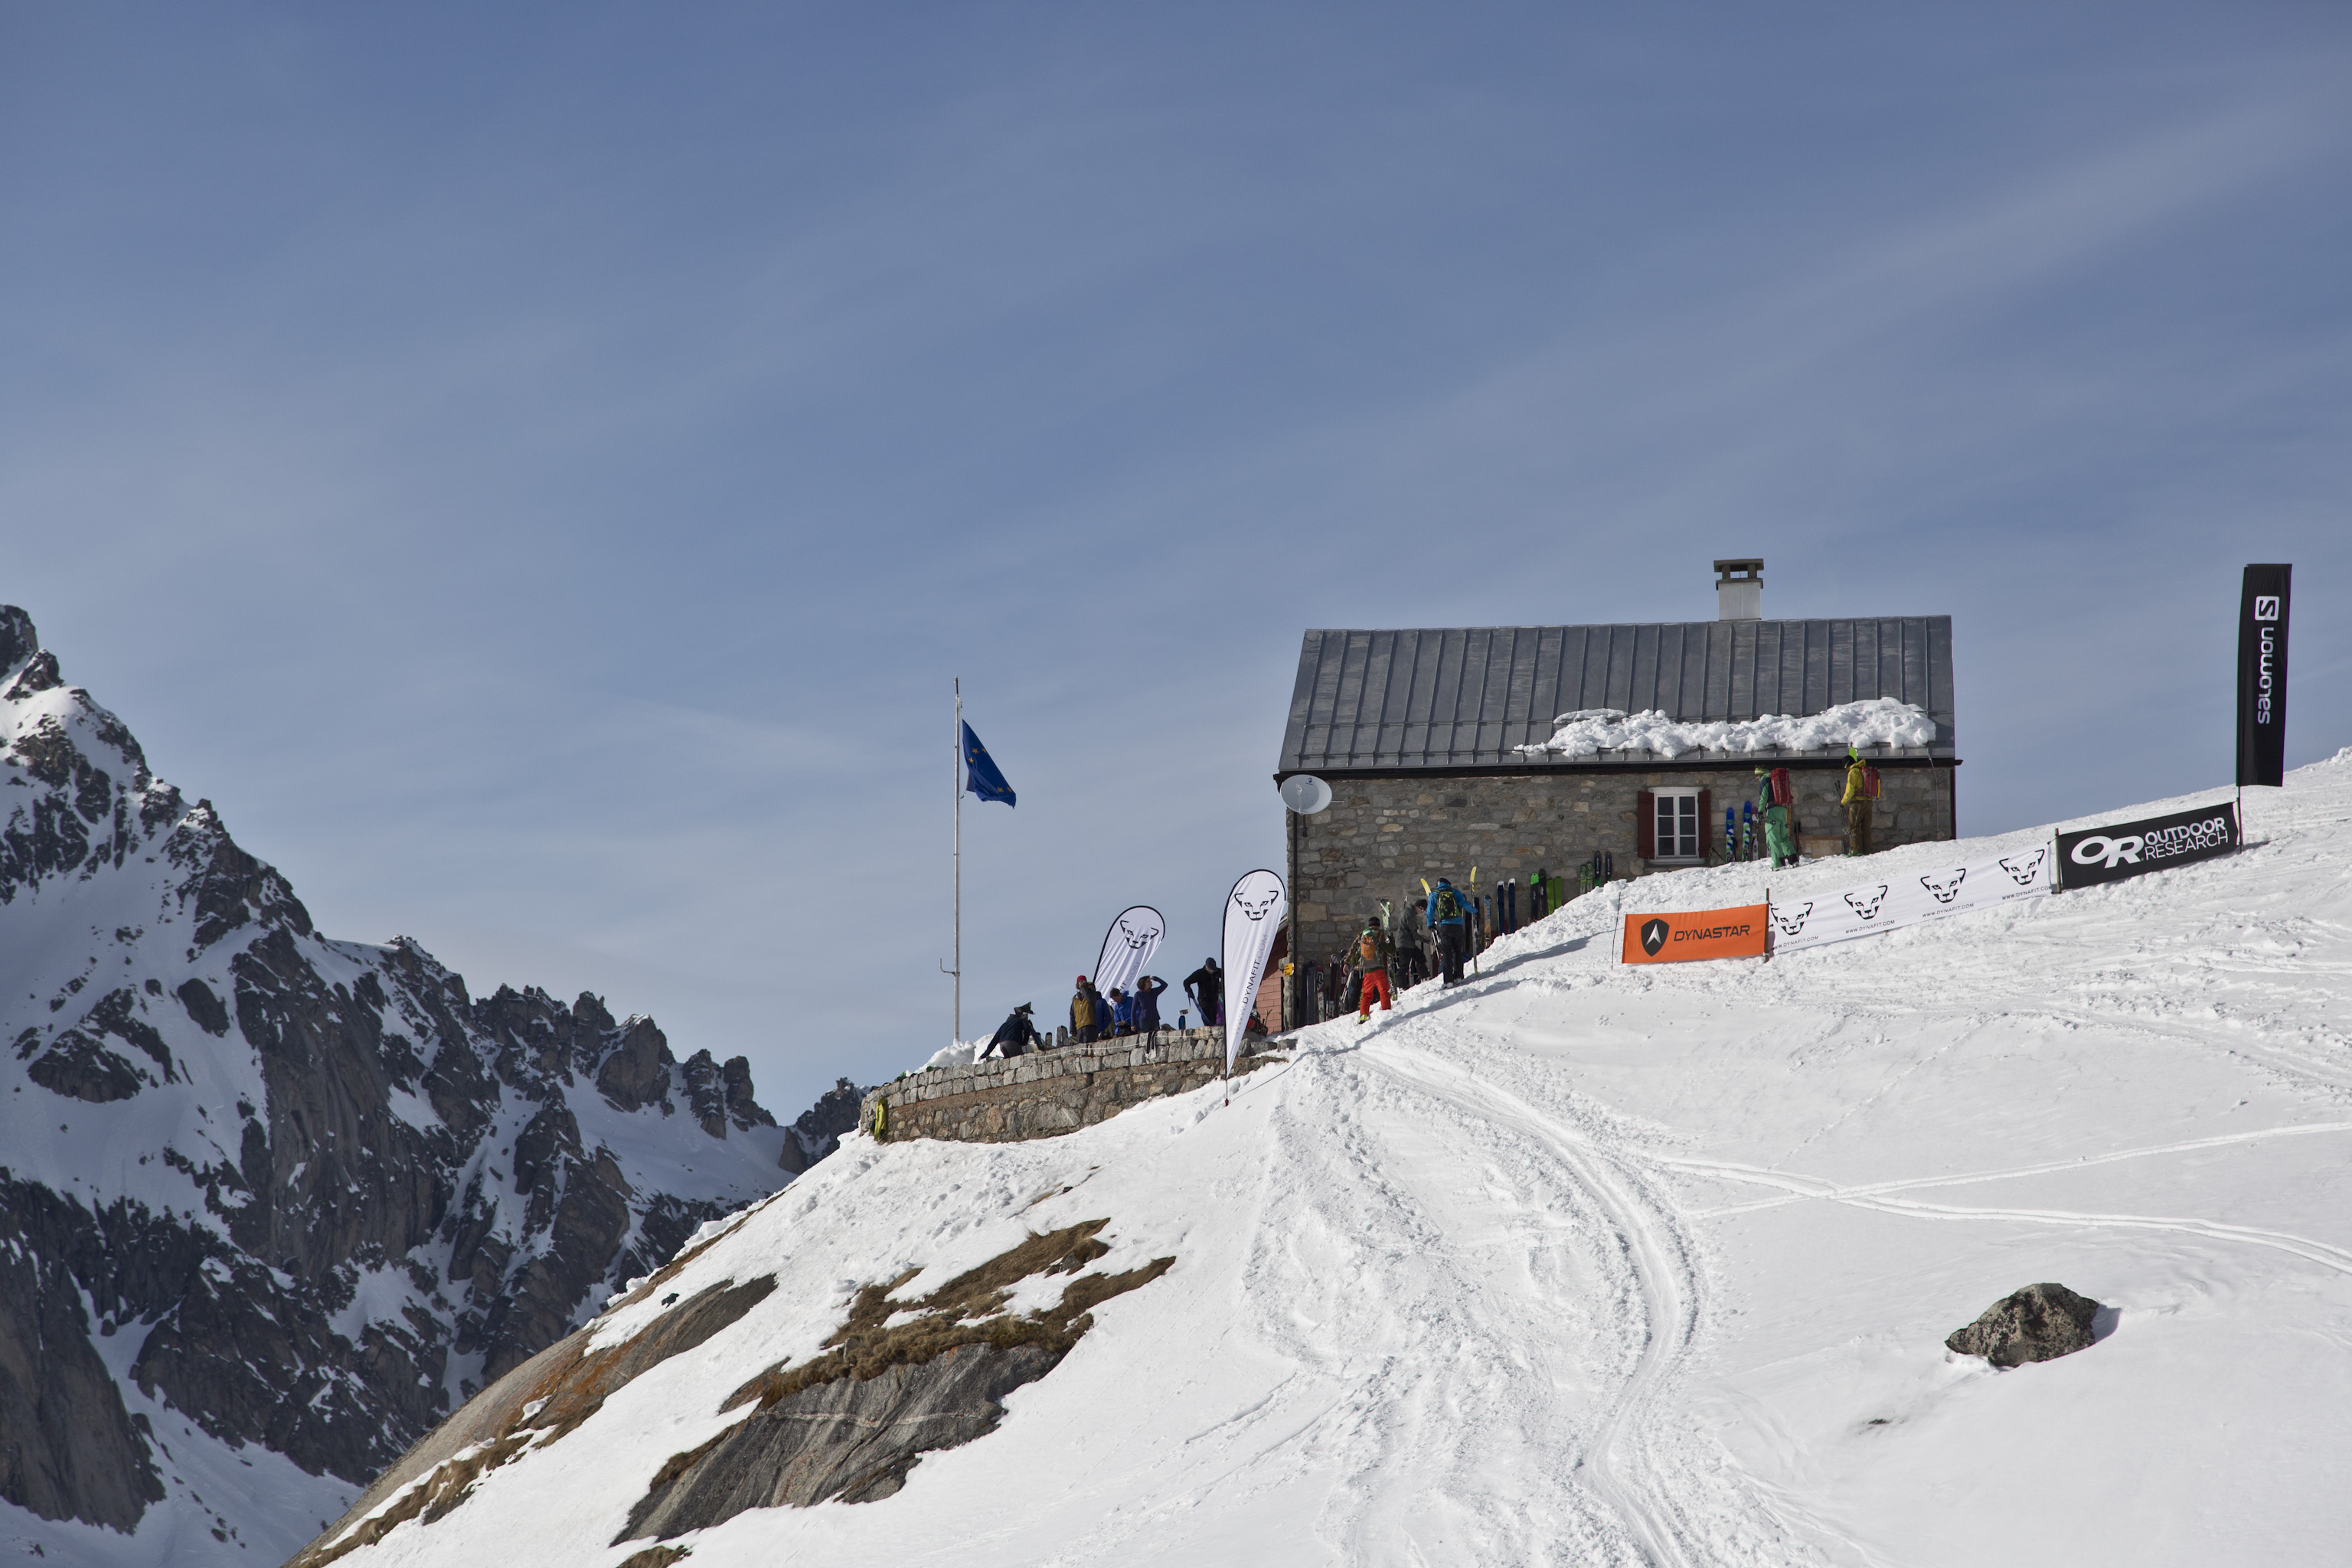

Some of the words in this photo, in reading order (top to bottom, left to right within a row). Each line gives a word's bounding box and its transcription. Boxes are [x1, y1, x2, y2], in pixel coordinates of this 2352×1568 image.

[2145, 817, 2226, 846] OUTDOOR
[2070, 835, 2145, 869] OR
[2145, 830, 2229, 861] RESEARCH
[1922, 903, 1975, 918] WWW.DYNAFIT.COM
[1674, 925, 1750, 942] DYNASTAR
[1845, 920, 1895, 934] WWW.DYNAFIT.COM
[1773, 936, 1819, 950] WW.DYNAFIT.COM
[1233, 934, 1269, 1035] WWW.DYNAFIT.COM
